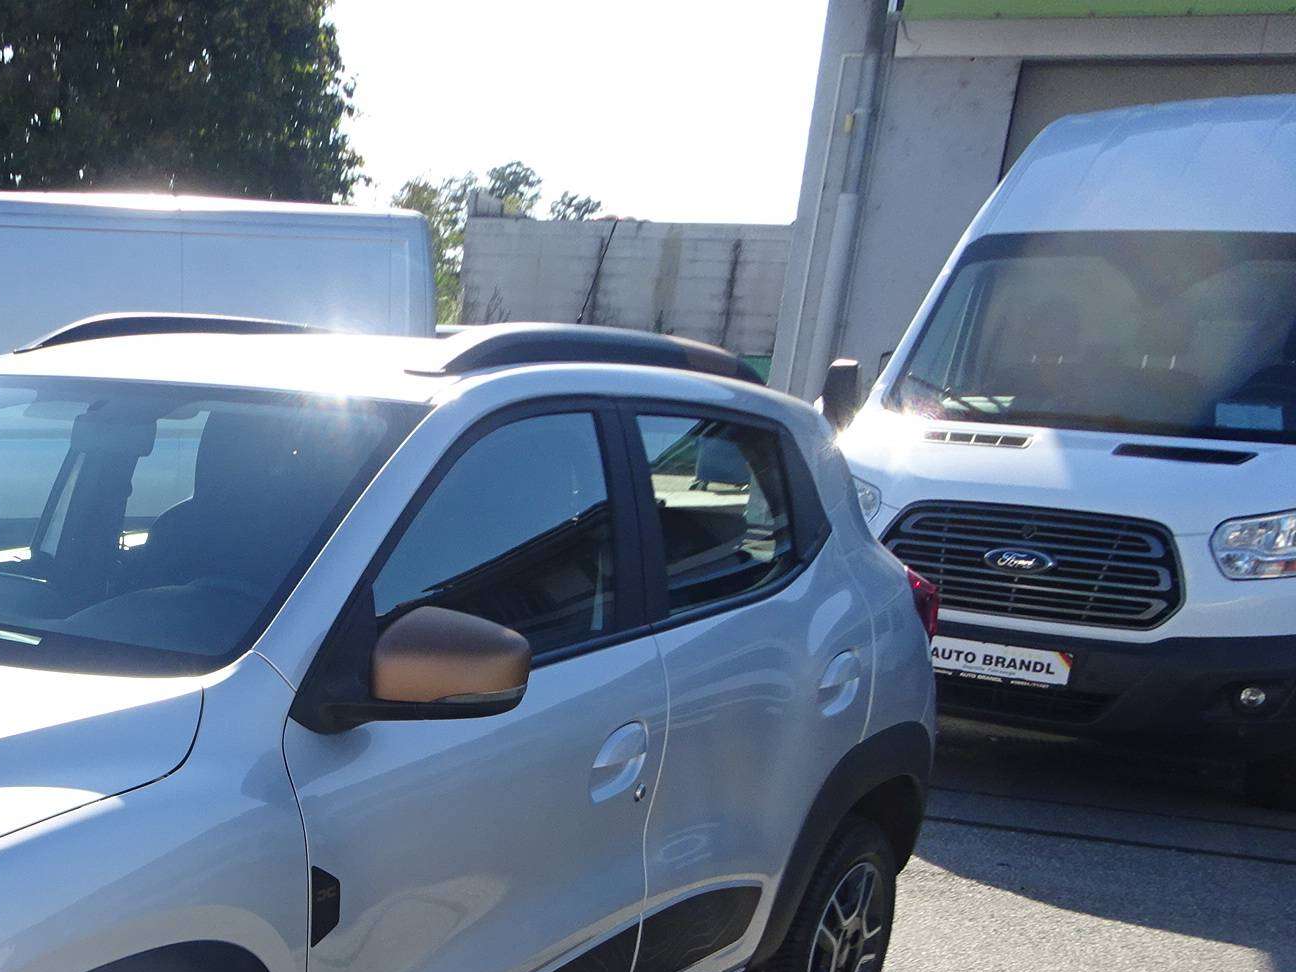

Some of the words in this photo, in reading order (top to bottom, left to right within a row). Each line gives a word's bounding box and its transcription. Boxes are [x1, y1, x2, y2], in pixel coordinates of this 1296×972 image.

[997, 551, 1036, 569] Ford
[931, 646, 976, 664] AUTO
[982, 654, 1055, 675] BRANDL
